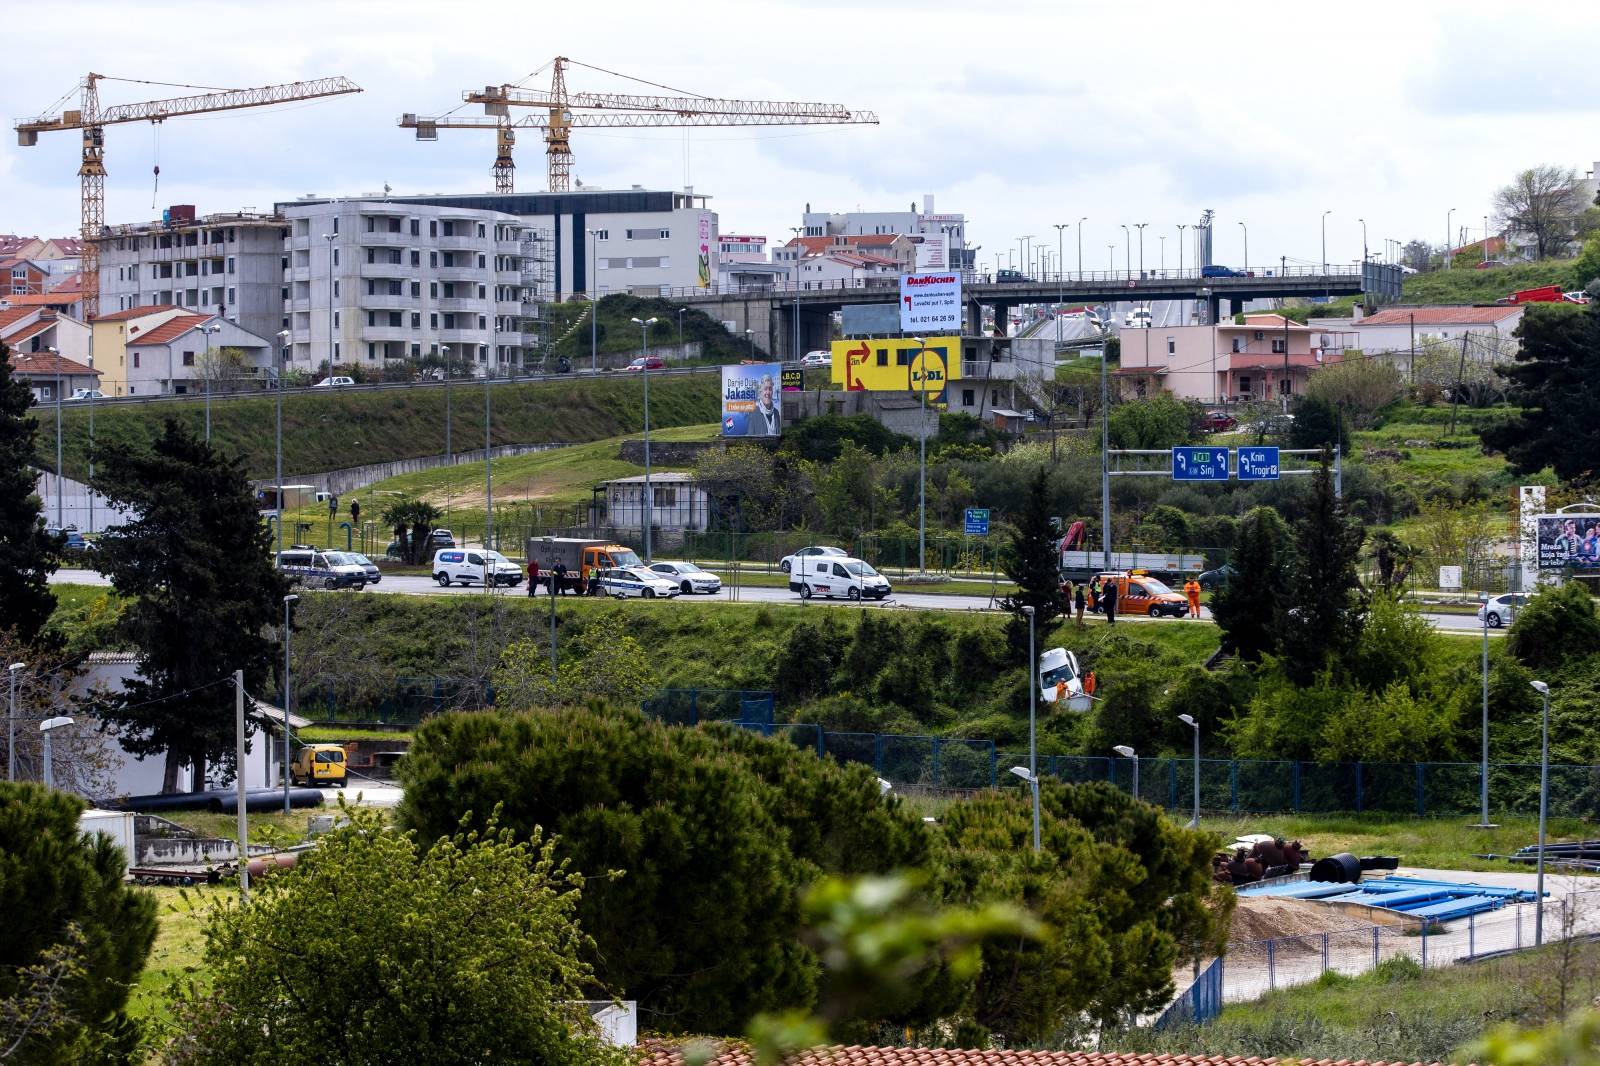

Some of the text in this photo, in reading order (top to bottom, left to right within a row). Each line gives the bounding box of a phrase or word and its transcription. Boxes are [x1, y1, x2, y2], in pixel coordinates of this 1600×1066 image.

[1250, 452, 1265, 462] Knin
[1200, 464, 1215, 478] Sinj
[1251, 465, 1270, 477] Trogir
